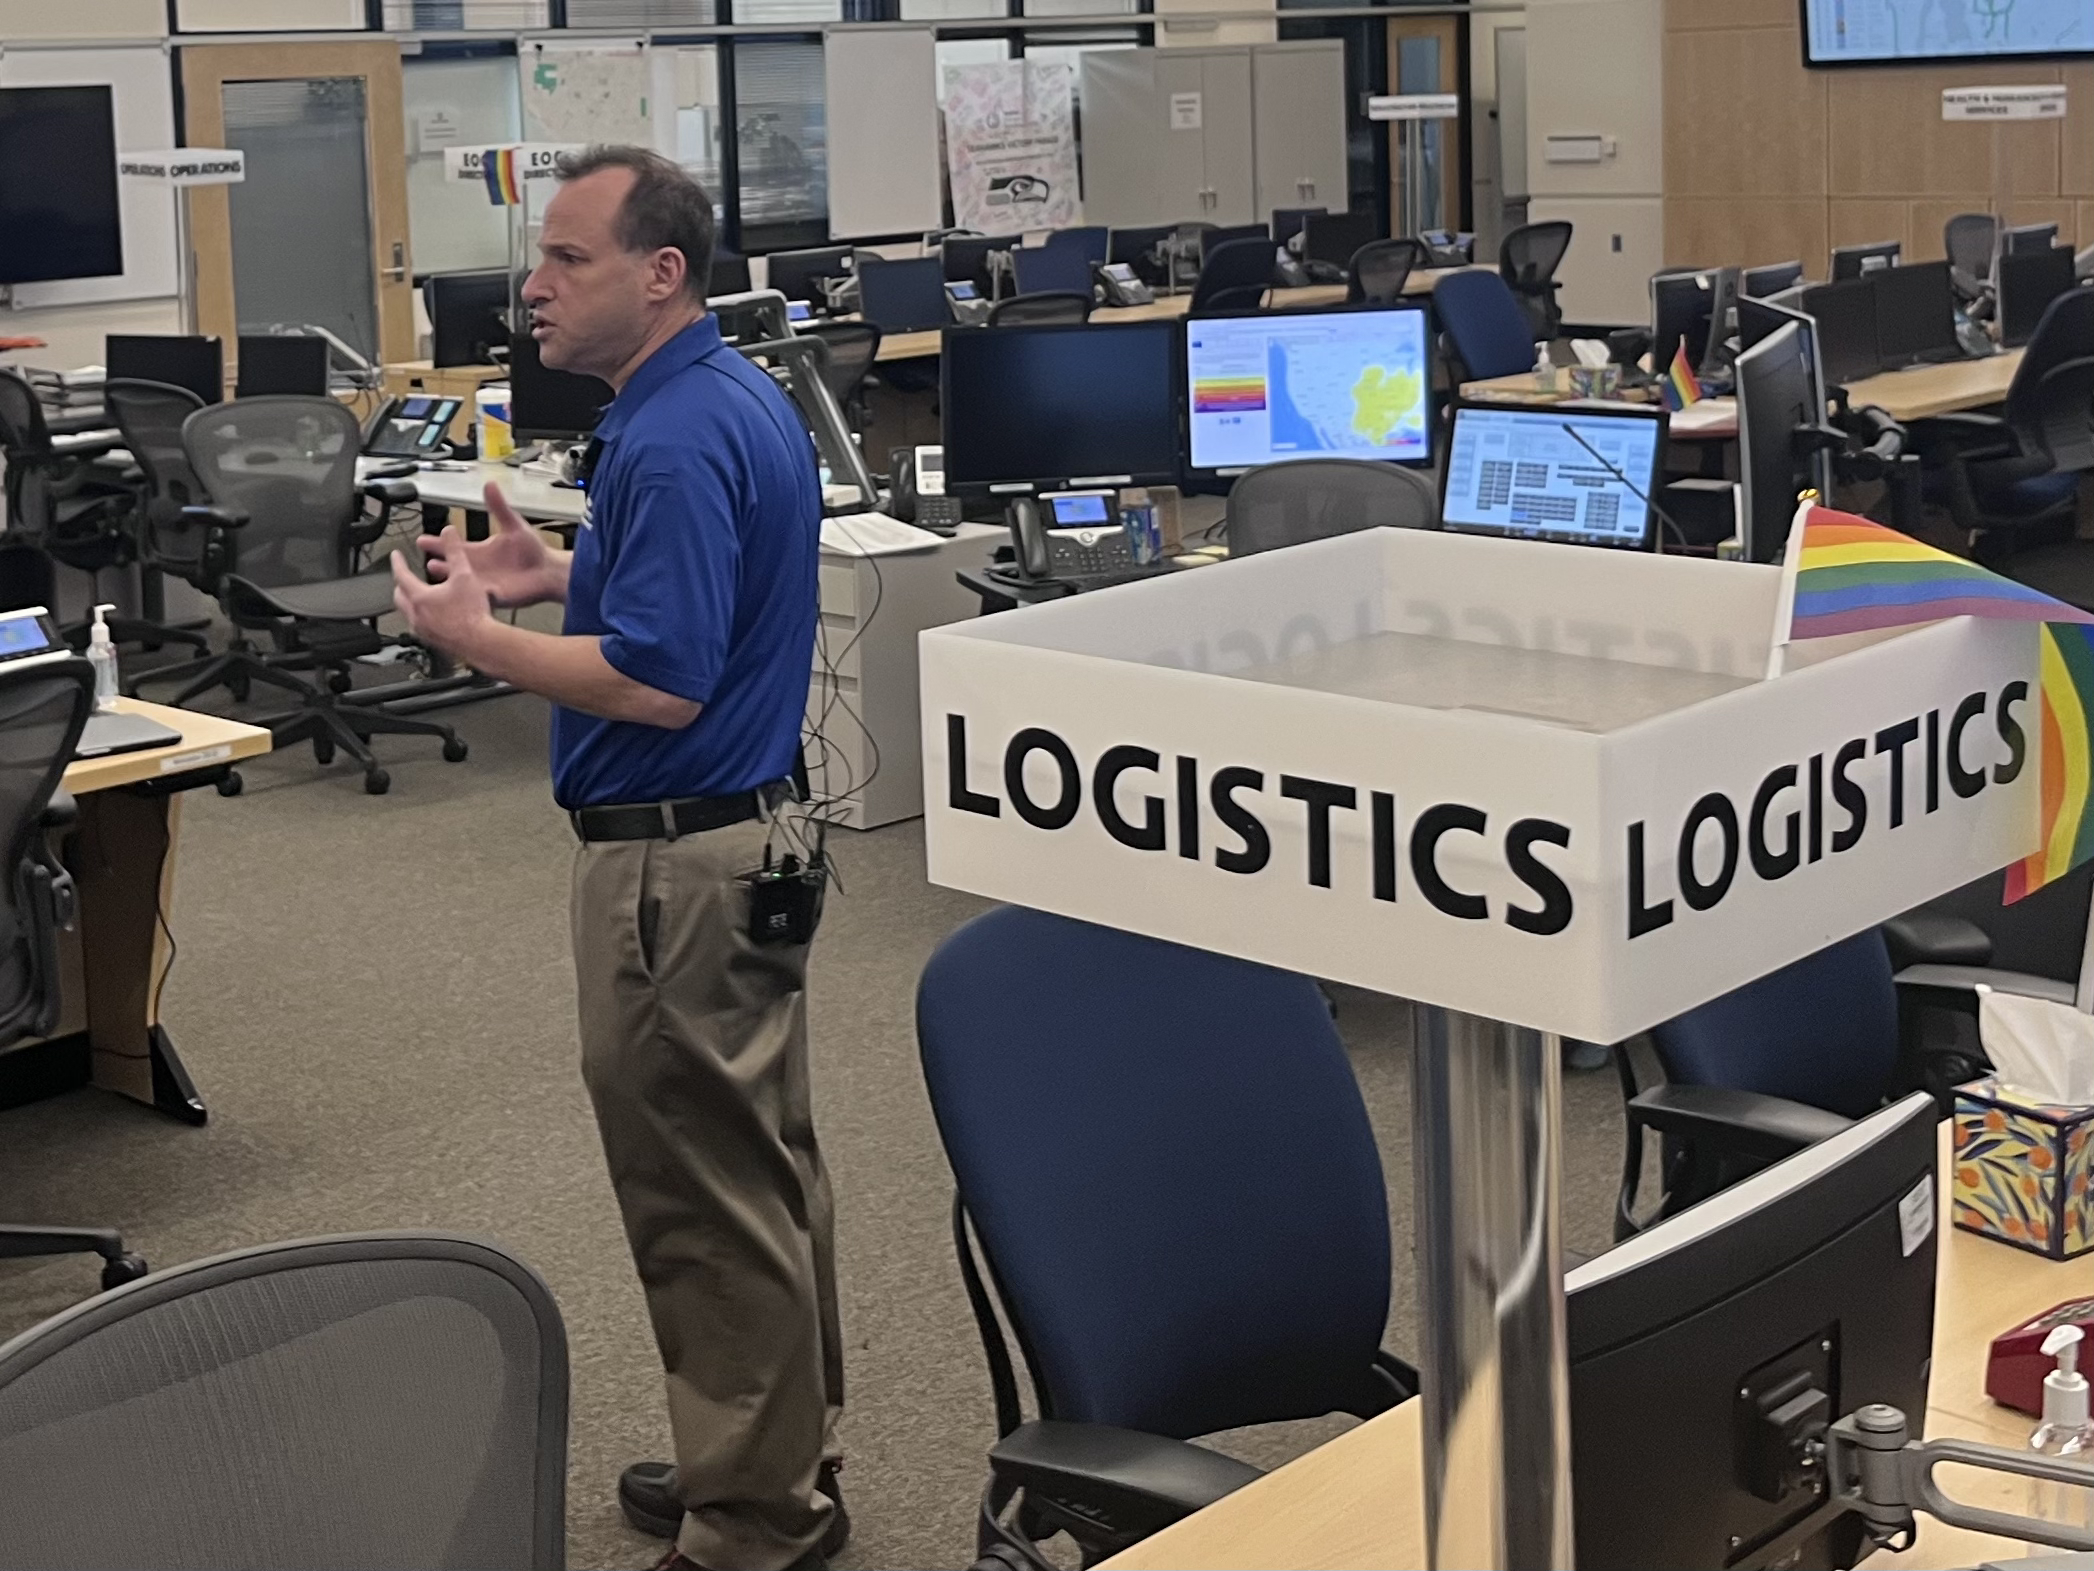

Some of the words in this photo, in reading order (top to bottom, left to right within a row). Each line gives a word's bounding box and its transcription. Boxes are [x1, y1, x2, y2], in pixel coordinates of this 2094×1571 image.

[170, 161, 241, 177] OPERATIONS
[463, 153, 481, 167] EO
[946, 713, 1574, 936] LOGISTICS
[1627, 680, 2030, 941] LOGISTICS
